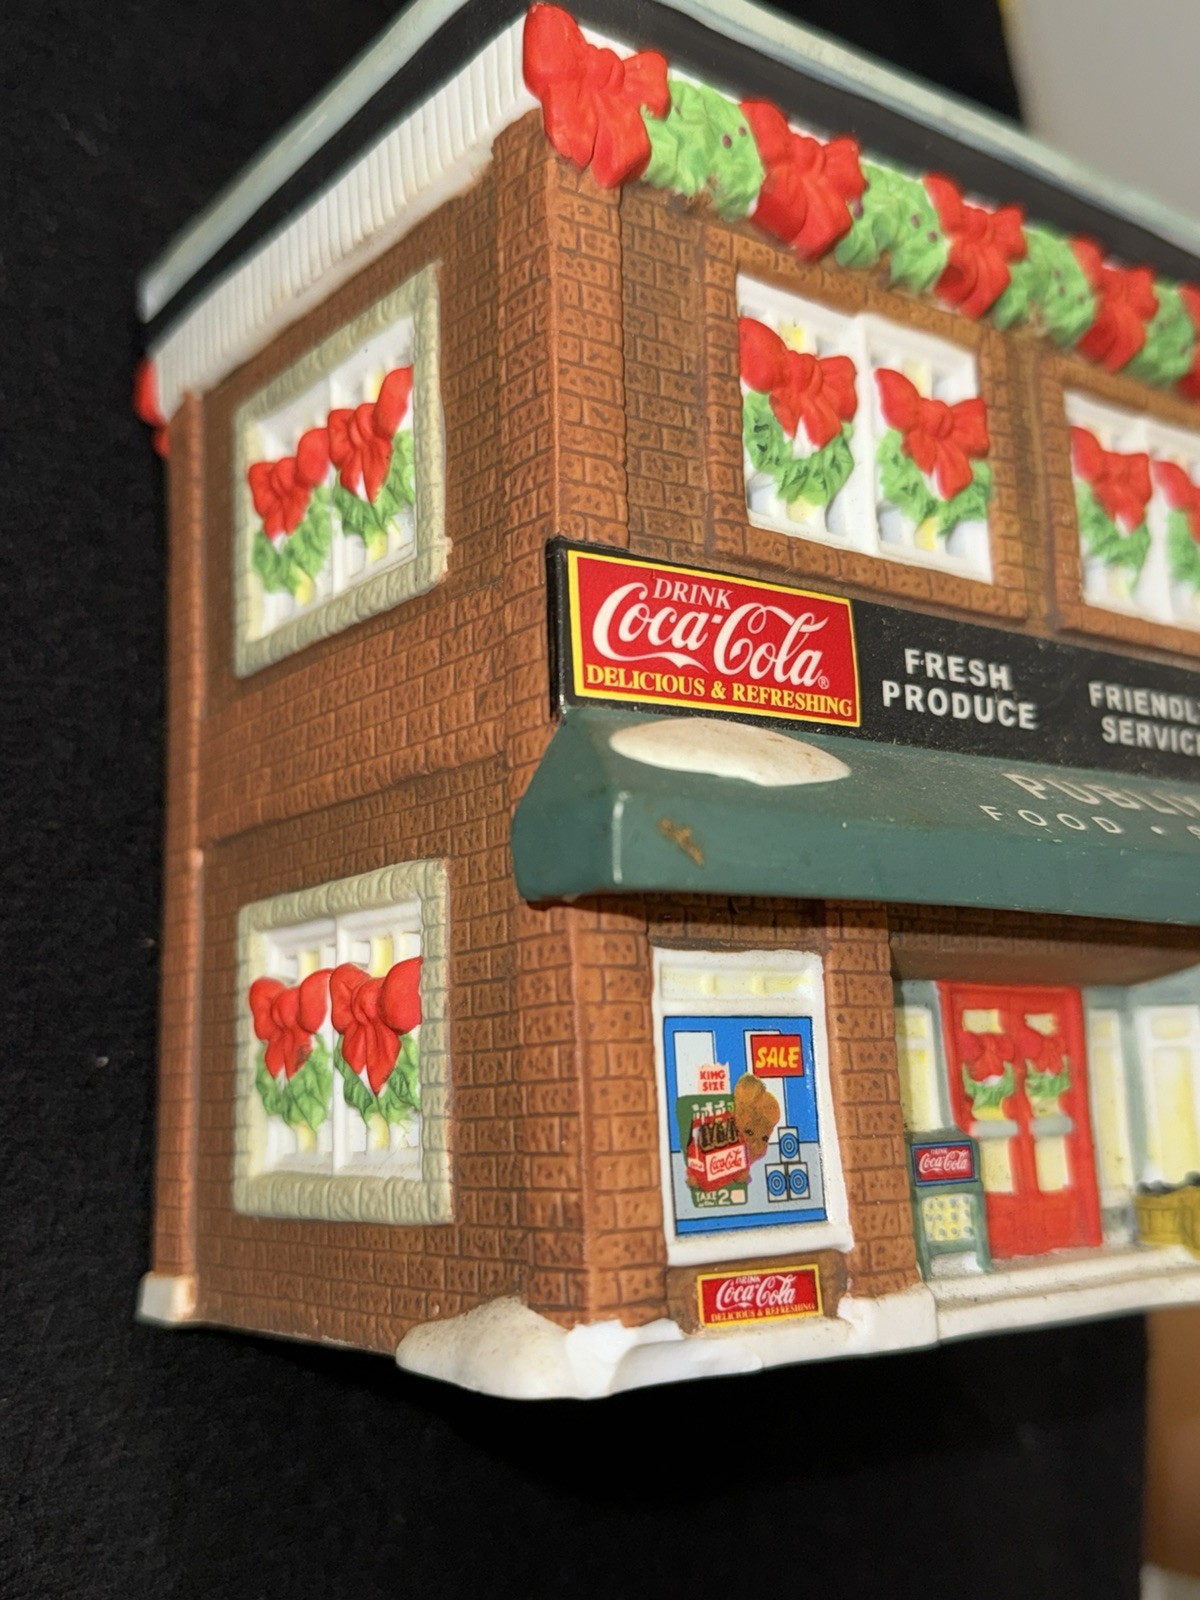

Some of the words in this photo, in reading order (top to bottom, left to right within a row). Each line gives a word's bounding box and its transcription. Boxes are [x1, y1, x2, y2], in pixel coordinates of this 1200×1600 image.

[652, 578, 733, 610] DRINK
[904, 648, 1013, 691] FRESH
[586, 664, 706, 697] DELICIOUS
[711, 684, 727, 699] &
[732, 683, 852, 717] REFRESHING
[882, 680, 1038, 730] PRODUCE
[979, 805, 1123, 834] FOOD
[755, 1046, 800, 1068] SALE
[700, 1070, 726, 1080] KING
[702, 1081, 725, 1092] SIZE
[718, 1189, 731, 1205] 2
[716, 1274, 797, 1311] Coca-Cola
